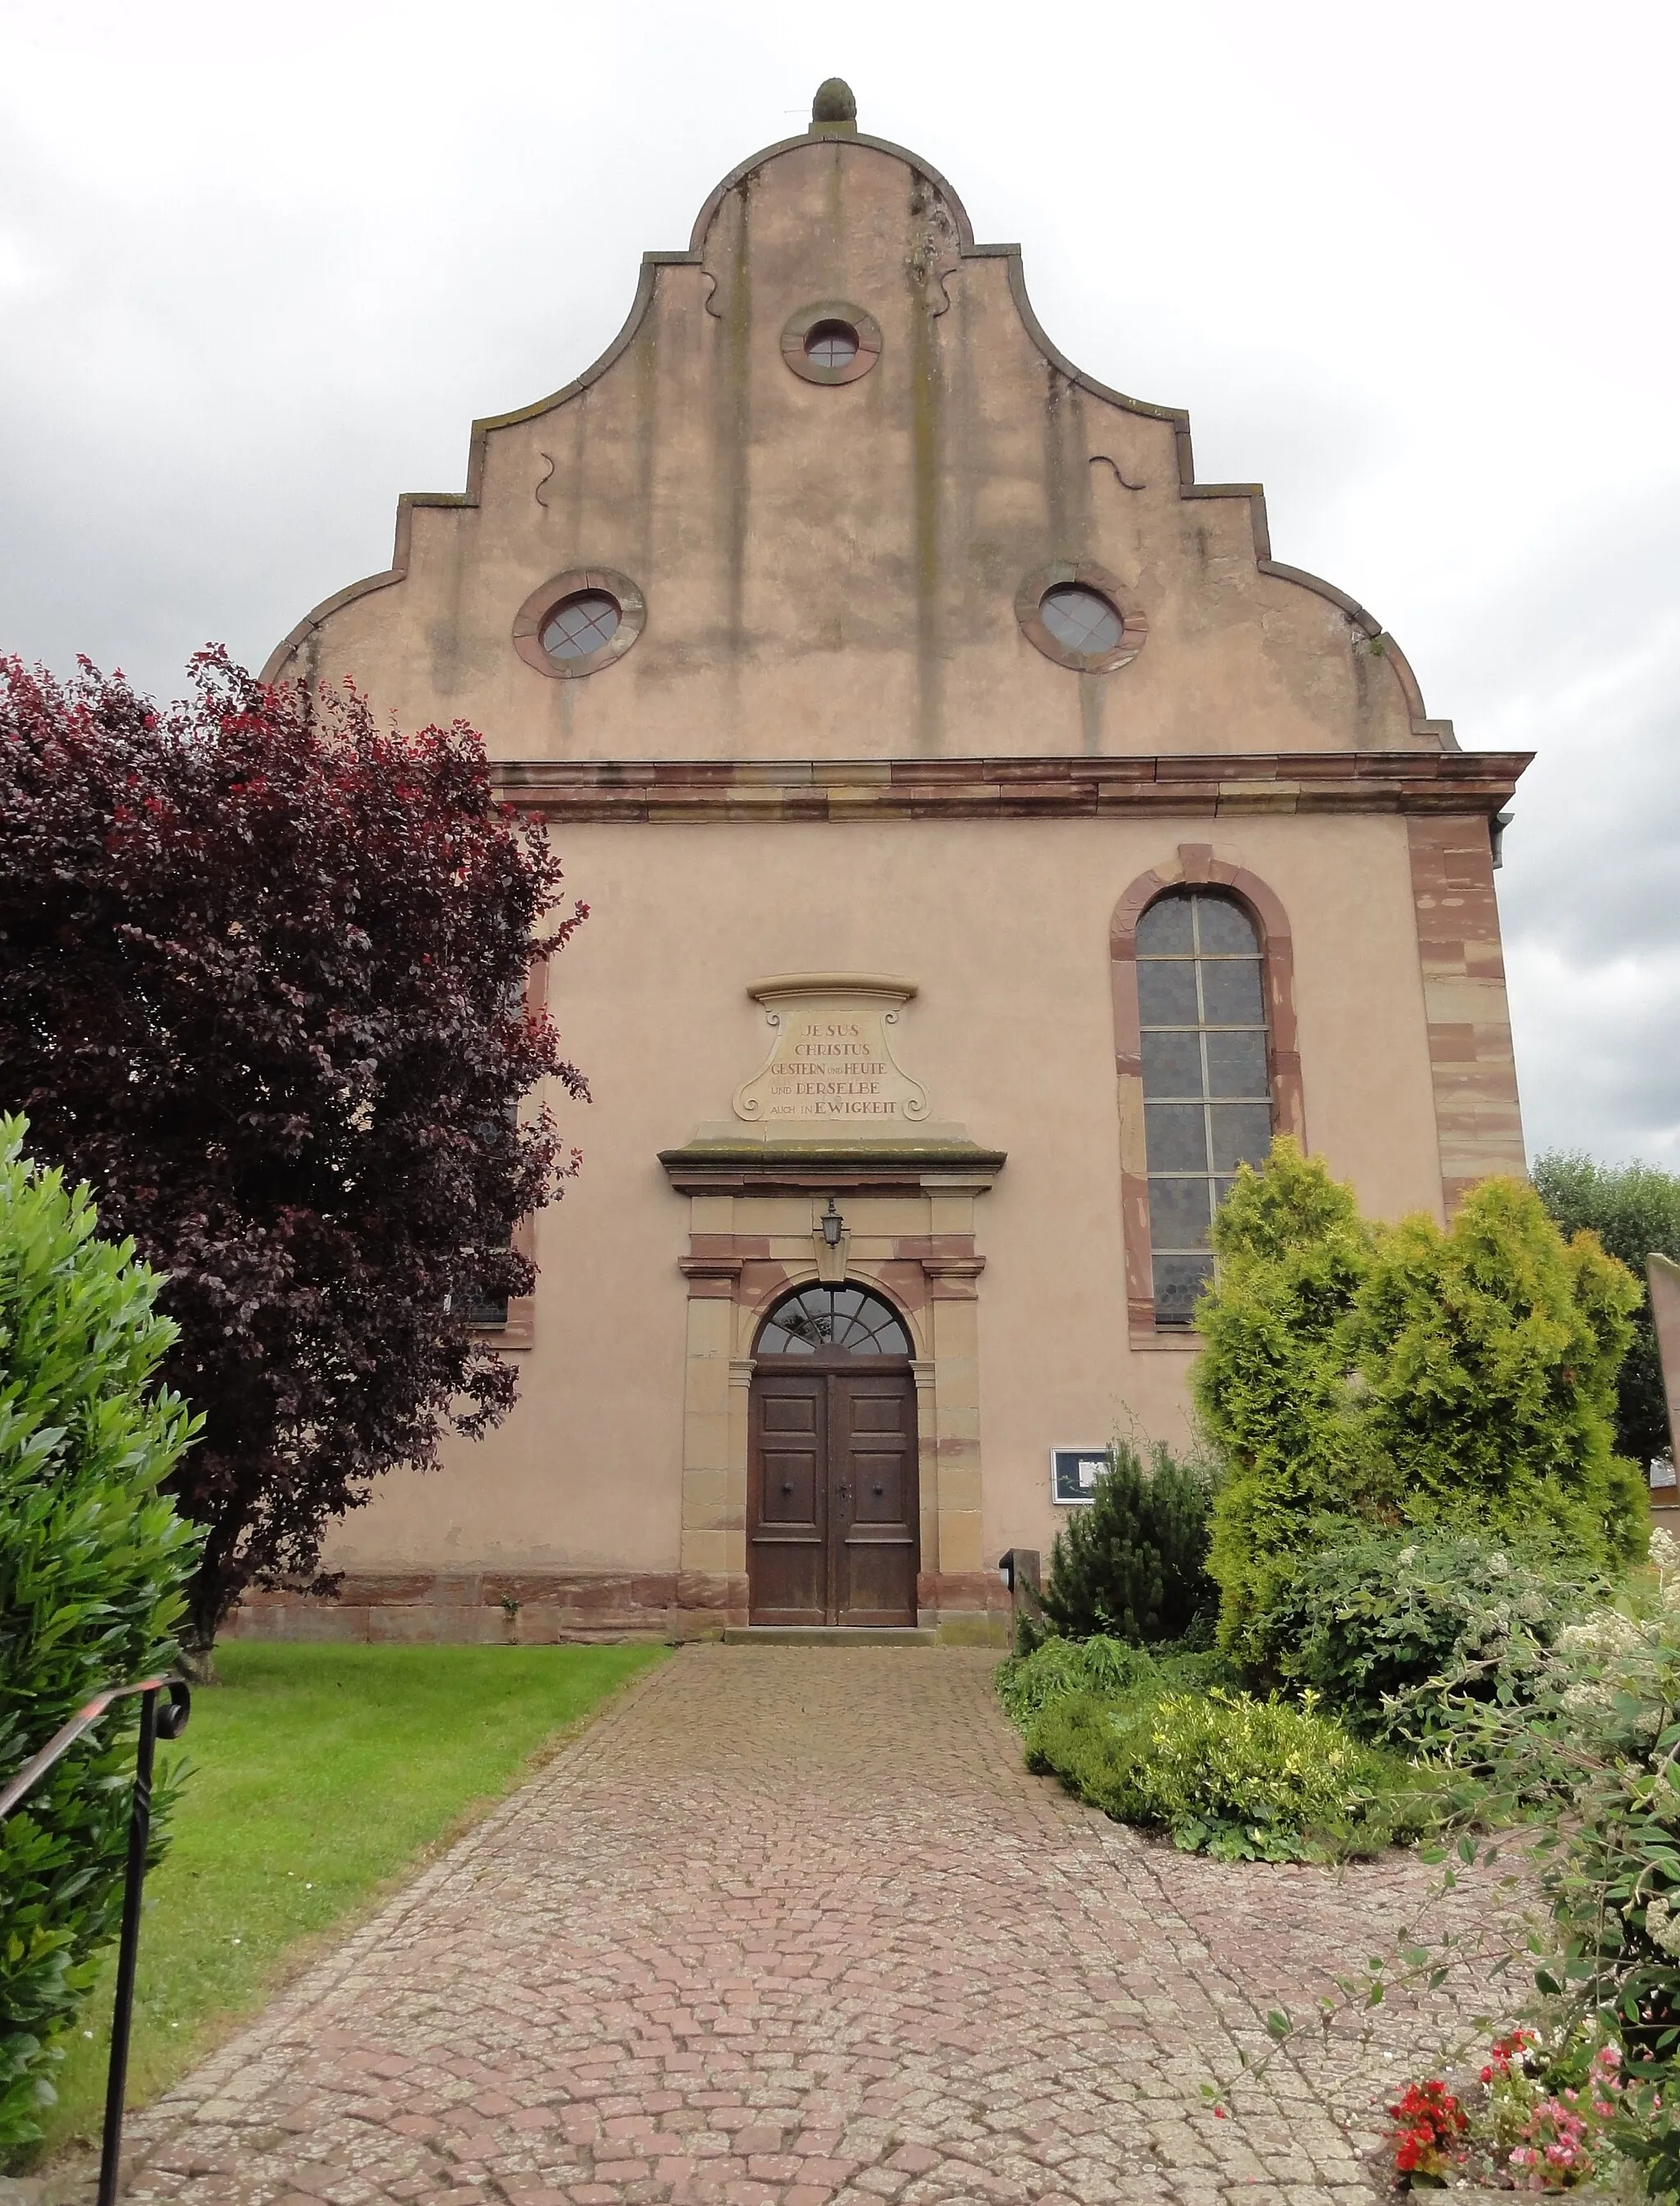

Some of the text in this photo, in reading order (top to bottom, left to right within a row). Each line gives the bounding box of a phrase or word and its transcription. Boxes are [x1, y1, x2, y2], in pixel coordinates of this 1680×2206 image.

[801, 1025, 859, 1036] JESUS
[795, 1044, 870, 1056] CHRISTUS
[771, 1063, 825, 1075] GESTERN
[845, 1063, 887, 1074] HEUTE
[771, 1083, 879, 1094] UND DERSELBE
[770, 1106, 795, 1114] AUCH
[815, 1102, 897, 1114] EWIGKEIT
